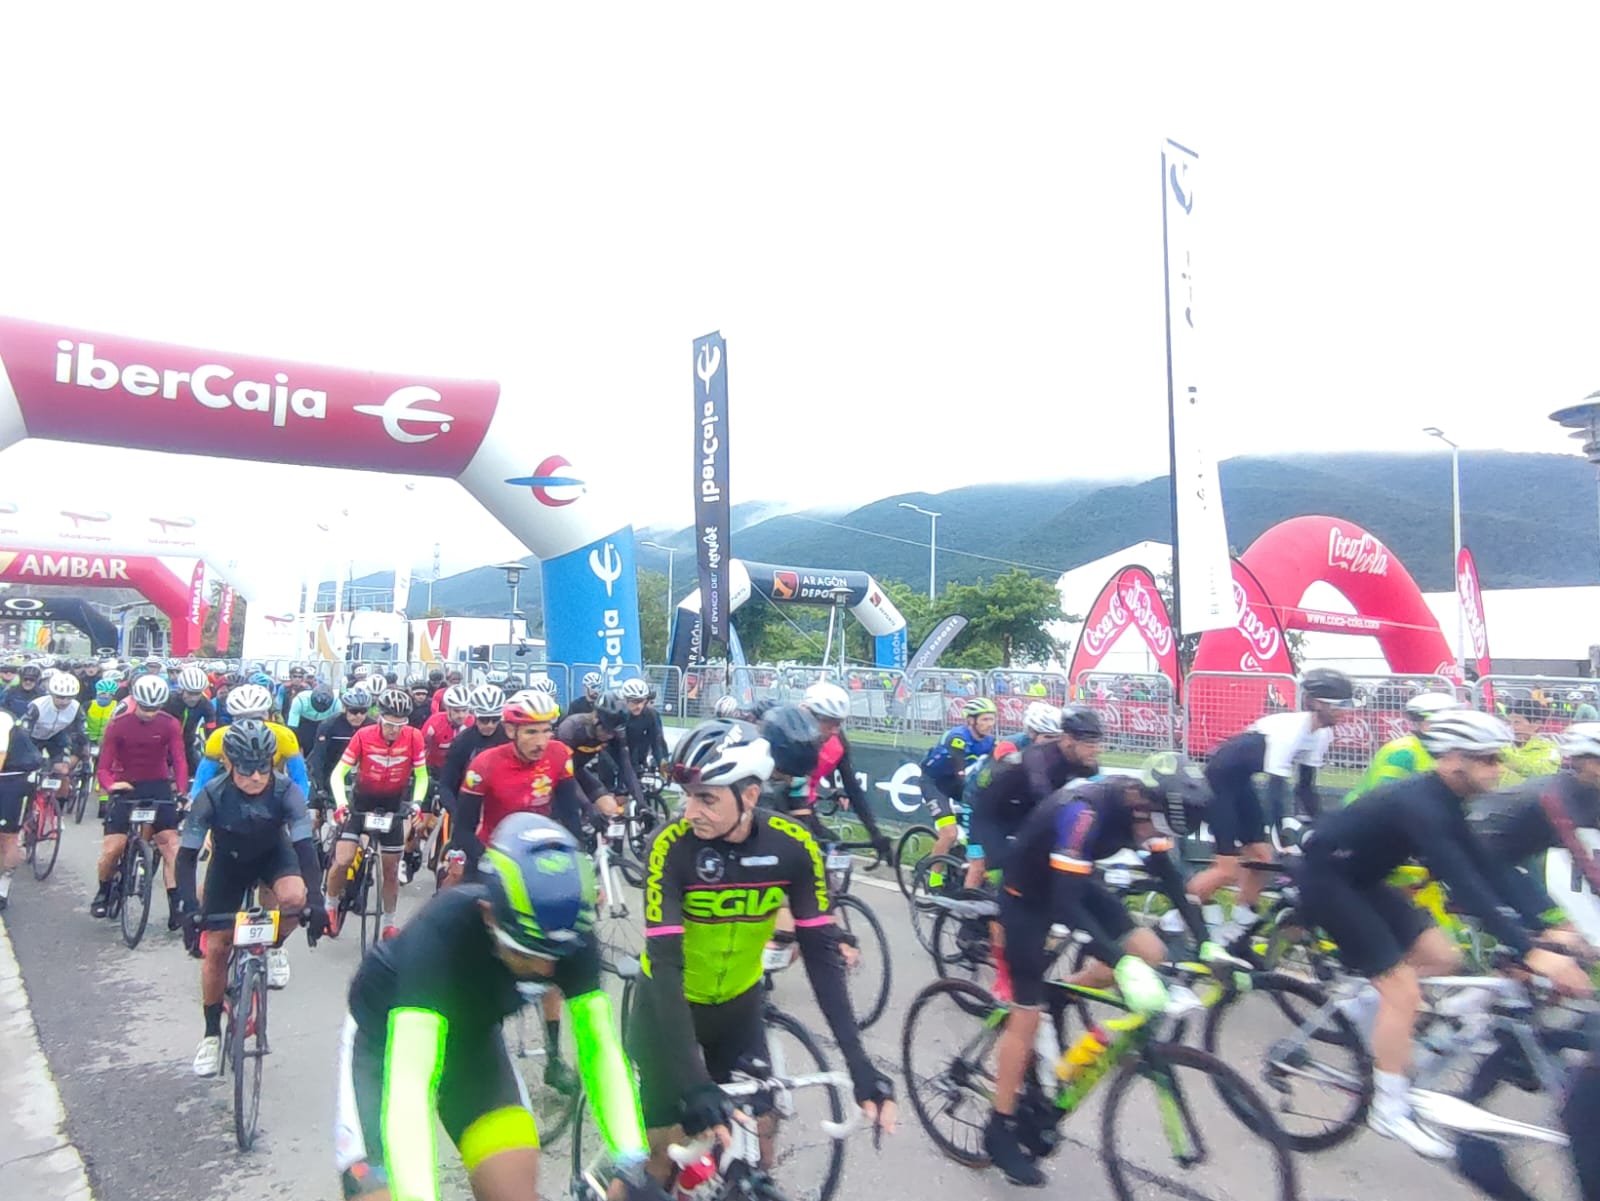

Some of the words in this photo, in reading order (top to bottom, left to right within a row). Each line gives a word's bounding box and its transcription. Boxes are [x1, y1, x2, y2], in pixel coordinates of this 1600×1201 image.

[55, 340, 327, 426] iberCaja
[20, 554, 130, 580] AMBAR
[801, 588, 836, 600] DEPOR
[802, 575, 848, 587] ARAGÓN
[192, 579, 202, 625] AMBAR
[222, 586, 233, 625] AMBA
[249, 927, 264, 938] 97
